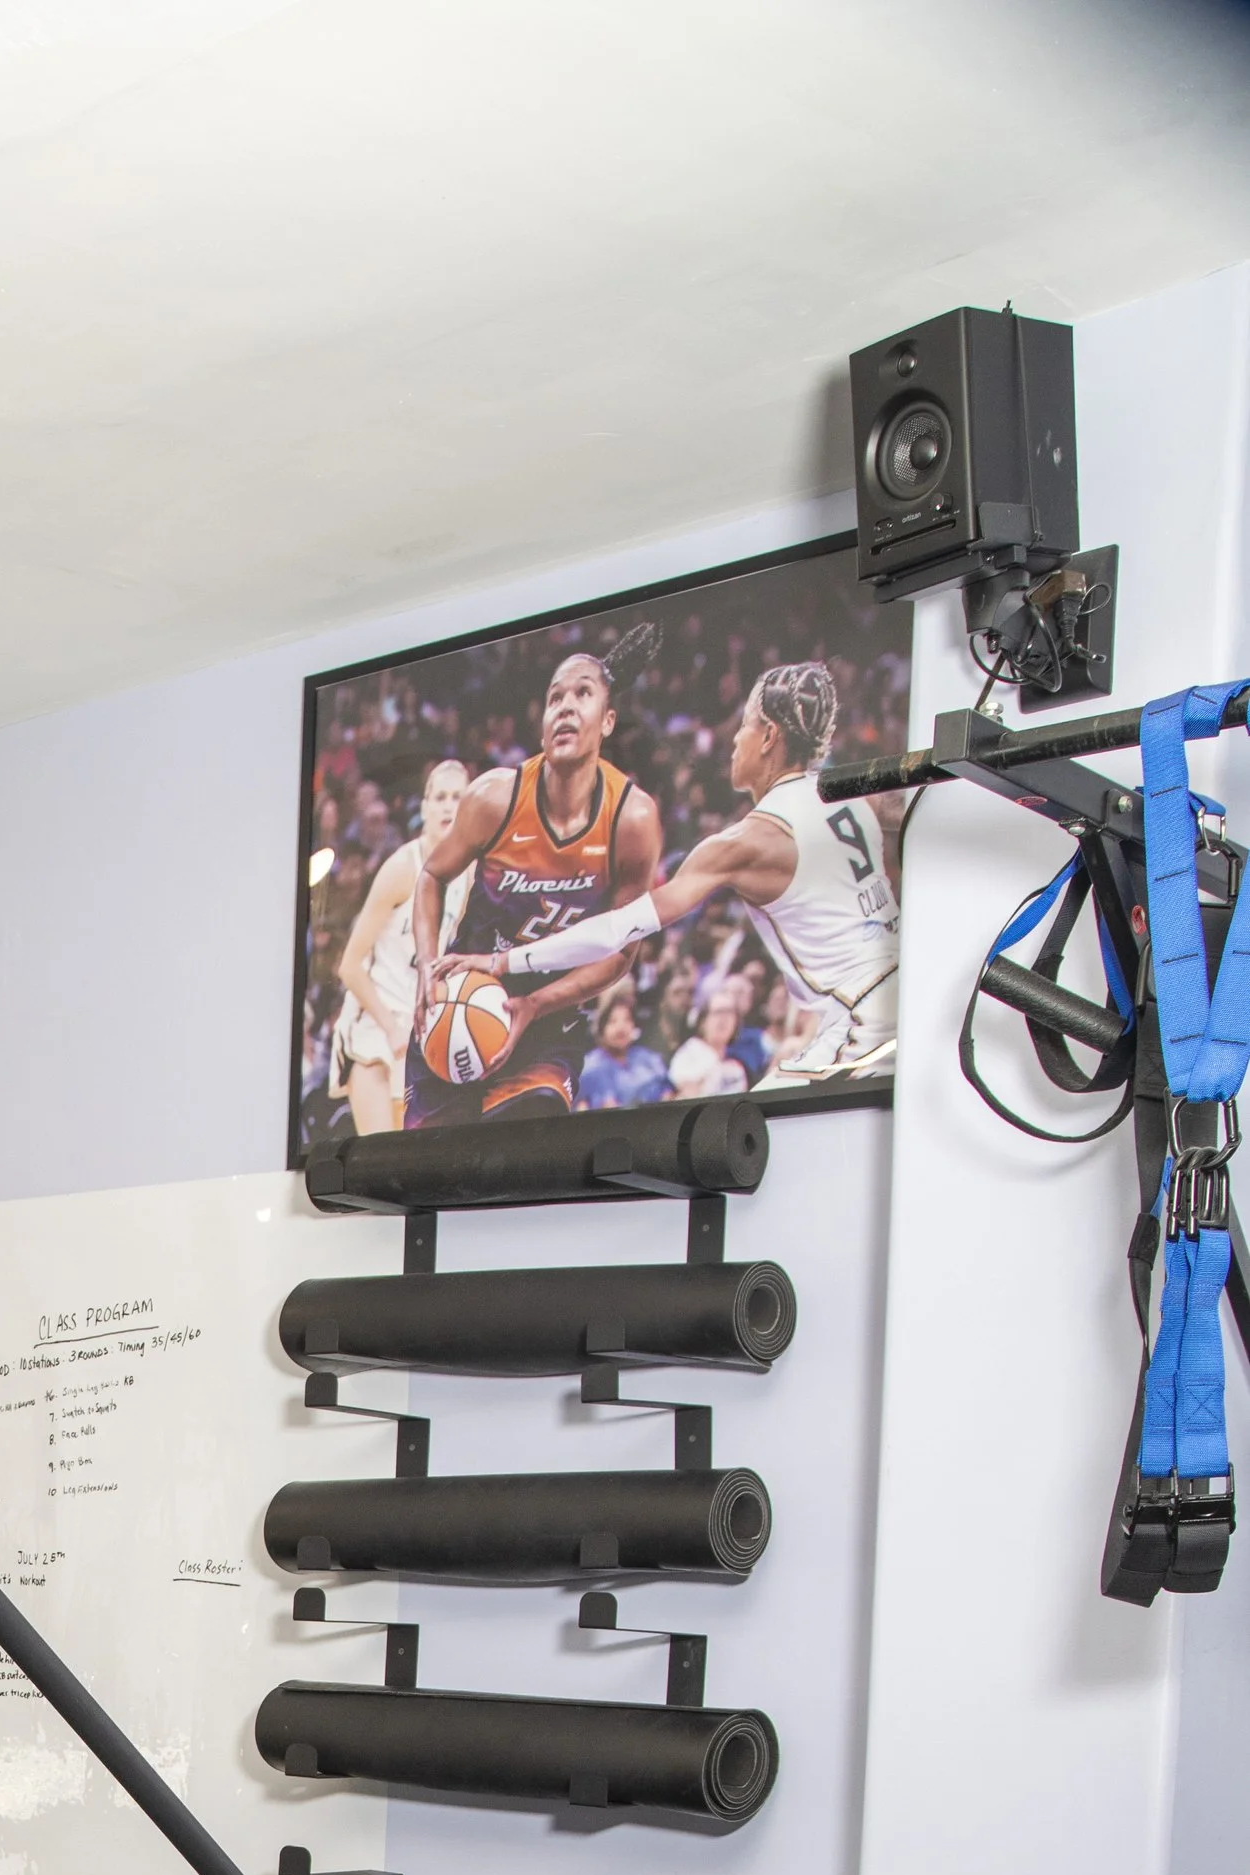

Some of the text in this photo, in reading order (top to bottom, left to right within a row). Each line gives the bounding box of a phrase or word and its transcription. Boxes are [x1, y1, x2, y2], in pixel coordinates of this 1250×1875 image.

[826, 806, 874, 883] 9
[498, 869, 597, 894] Phoenix
[39, 1298, 154, 1341] CLASS PROGRAM
[151, 1325, 202, 1352] 35/45/60
[17, 1550, 38, 1566] JULY
[178, 1559, 202, 1575] Class
[19, 1574, 46, 1587] Workout
